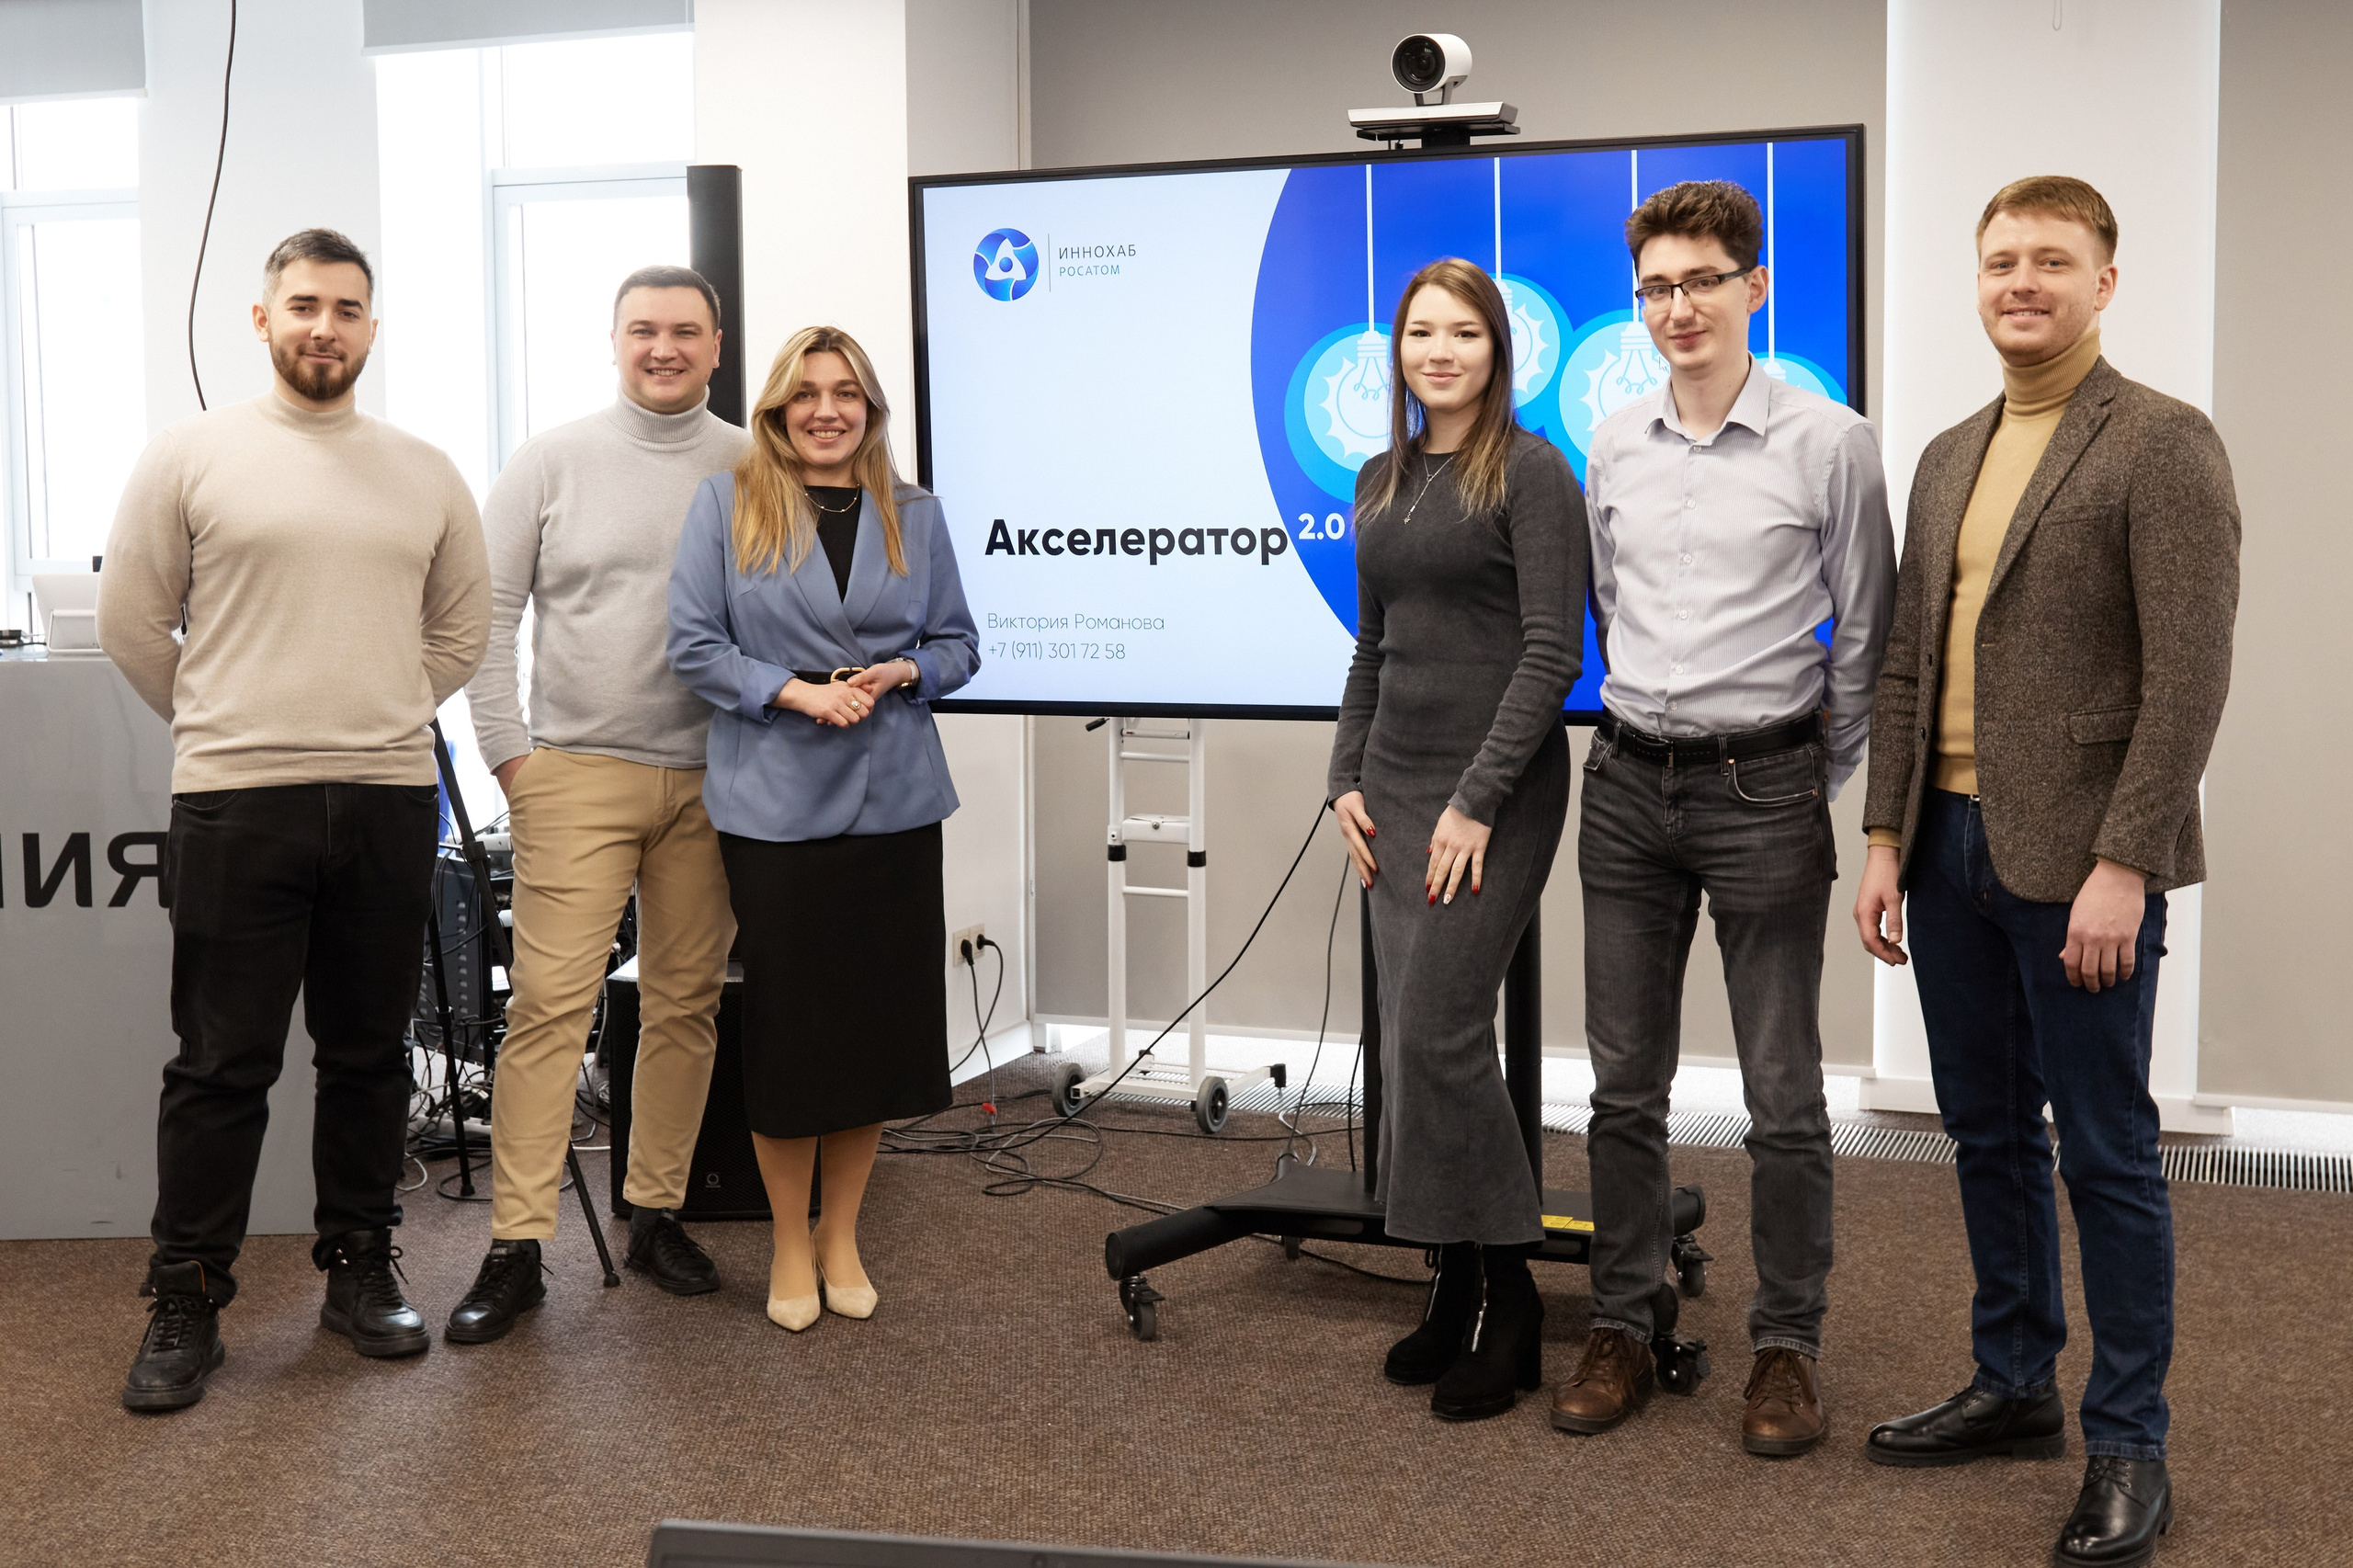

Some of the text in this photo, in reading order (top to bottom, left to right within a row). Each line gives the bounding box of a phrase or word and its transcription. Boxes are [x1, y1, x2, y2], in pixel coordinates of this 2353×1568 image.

[1059, 244, 1137, 260] ИННОХАБ
[1059, 264, 1120, 277] РОСАТОМ
[984, 512, 1346, 566] Акселератор 2.0
[987, 612, 1165, 633] Виктория Романова
[988, 640, 1126, 661] +7 (911) 301 72 58
[0, 831, 171, 909] ИЯ
